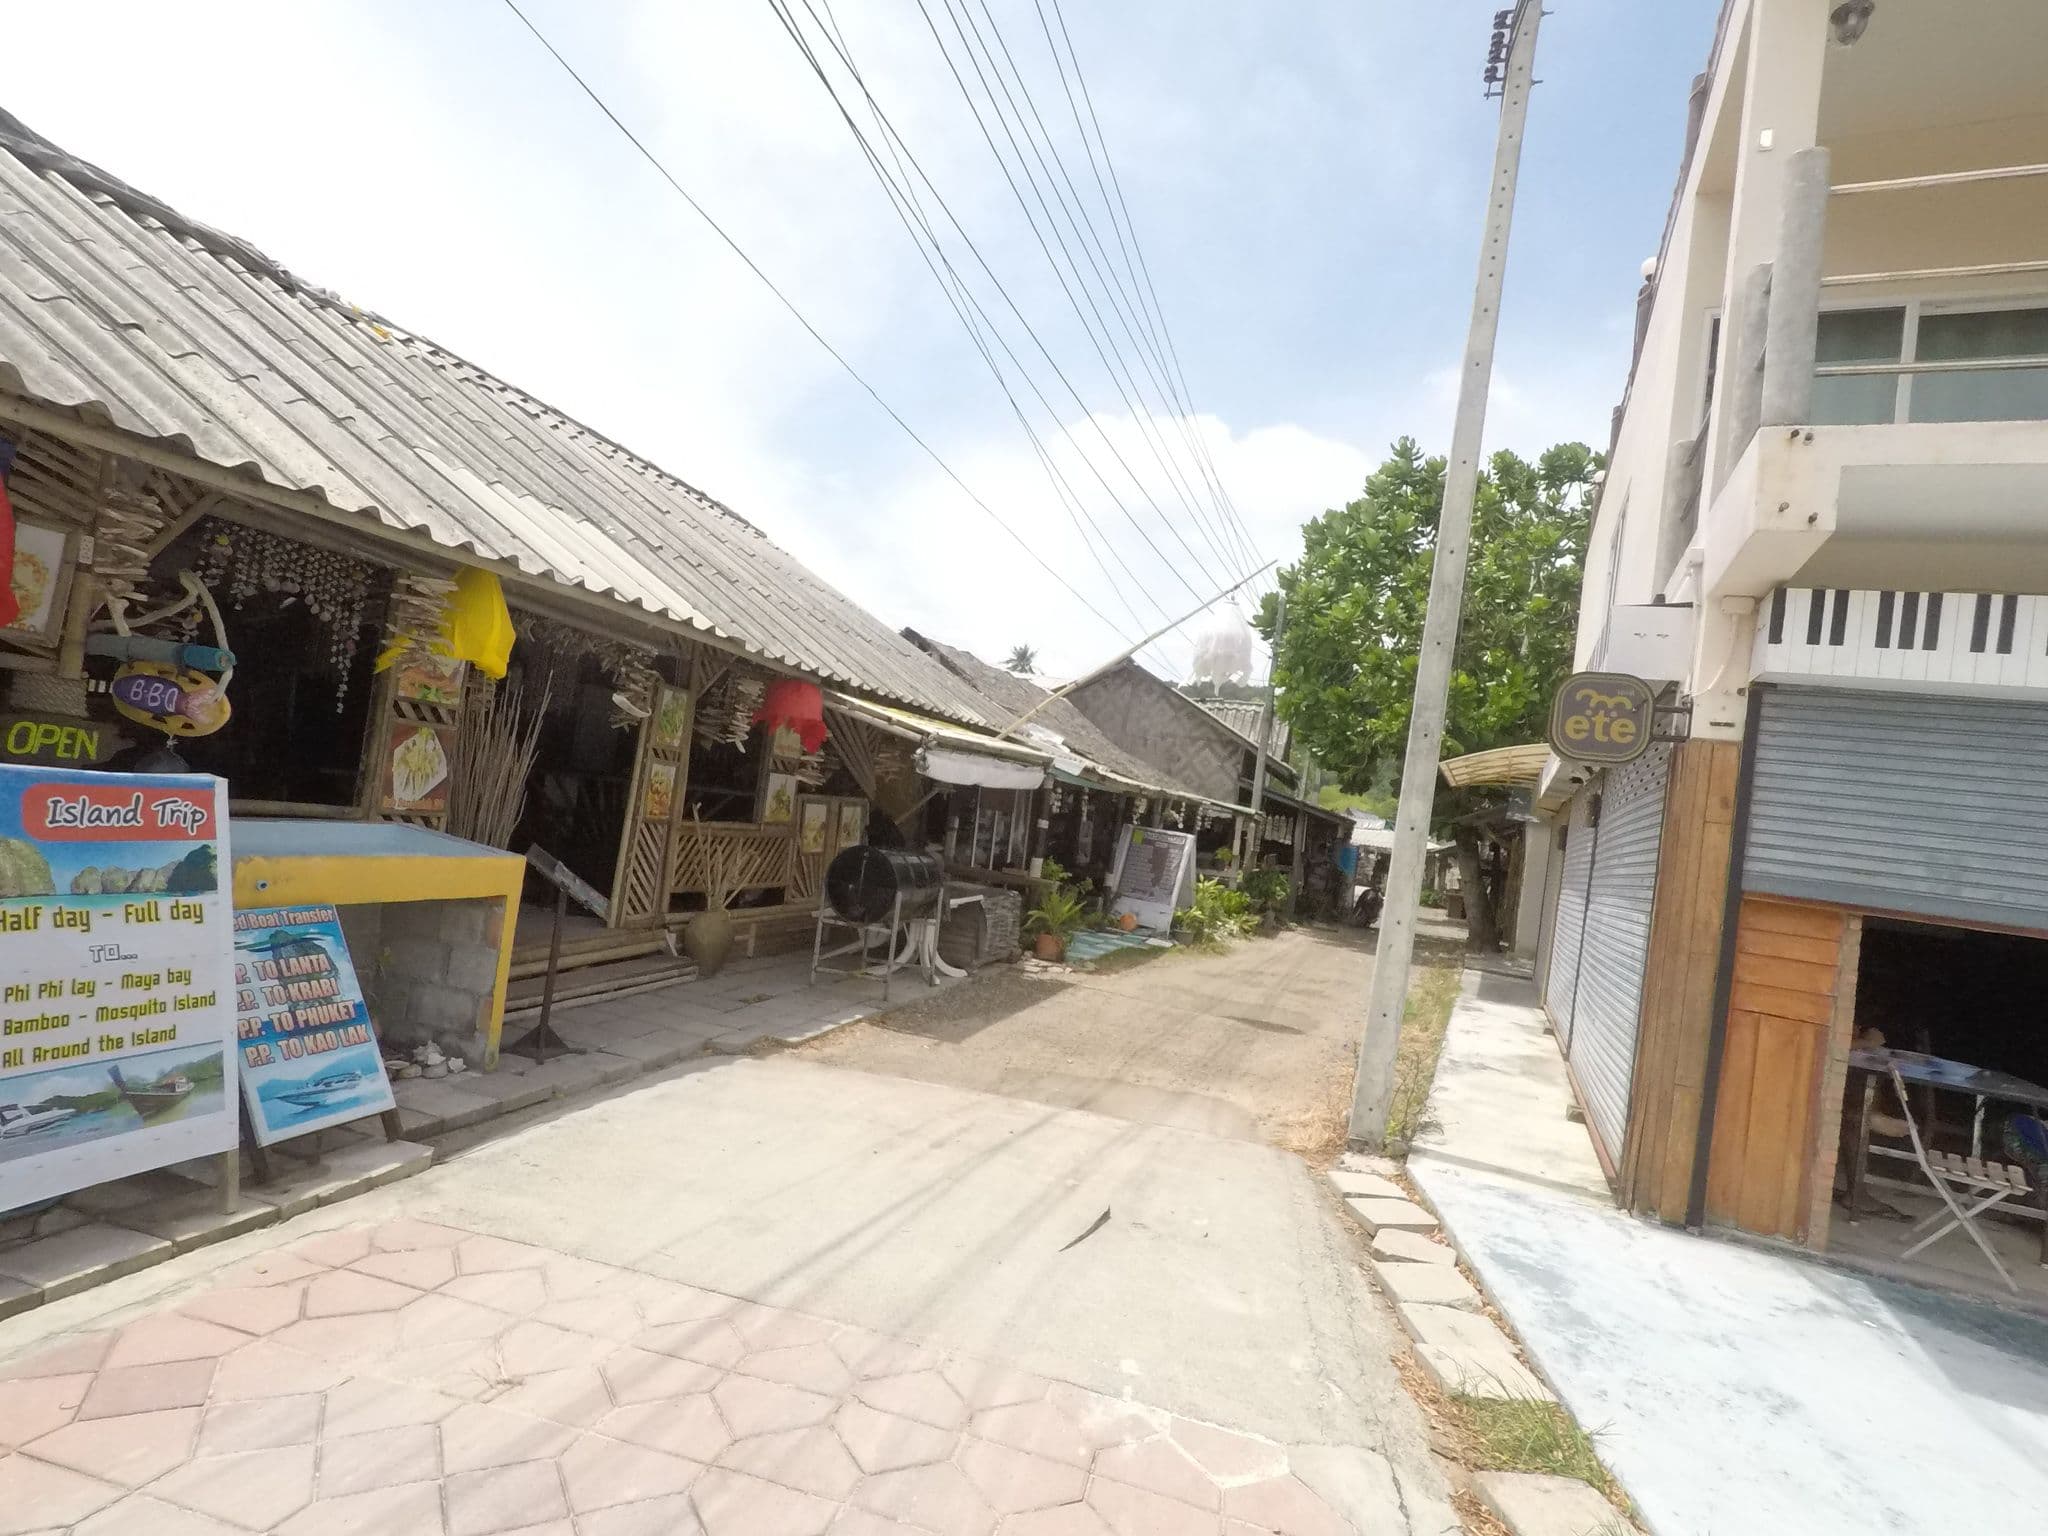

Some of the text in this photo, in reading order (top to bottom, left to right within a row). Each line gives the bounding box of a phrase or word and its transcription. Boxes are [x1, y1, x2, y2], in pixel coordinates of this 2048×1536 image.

[6, 721, 99, 760] OPEN
[46, 792, 208, 836] Island Trip
[53, 905, 91, 932] day
[124, 901, 160, 923] Full
[170, 899, 204, 923] day
[248, 911, 280, 930] Boat
[280, 908, 335, 926] Transfer
[4, 983, 30, 1003] Phi
[38, 980, 63, 999] Phi
[71, 978, 96, 997] lay
[121, 972, 160, 991] Maya
[167, 967, 192, 986] bay
[253, 960, 279, 981] TO
[279, 953, 331, 977] LANTA
[261, 985, 287, 1006] TO
[287, 978, 340, 1002] KRABI
[3, 1012, 70, 1036] Bamboo
[95, 999, 167, 1023] Mosquito
[268, 1011, 295, 1032] TO
[295, 999, 356, 1029] PHUKET
[2, 1024, 177, 1069] All Around the Island
[245, 1024, 371, 1068] P.P. TO KAO LAK
